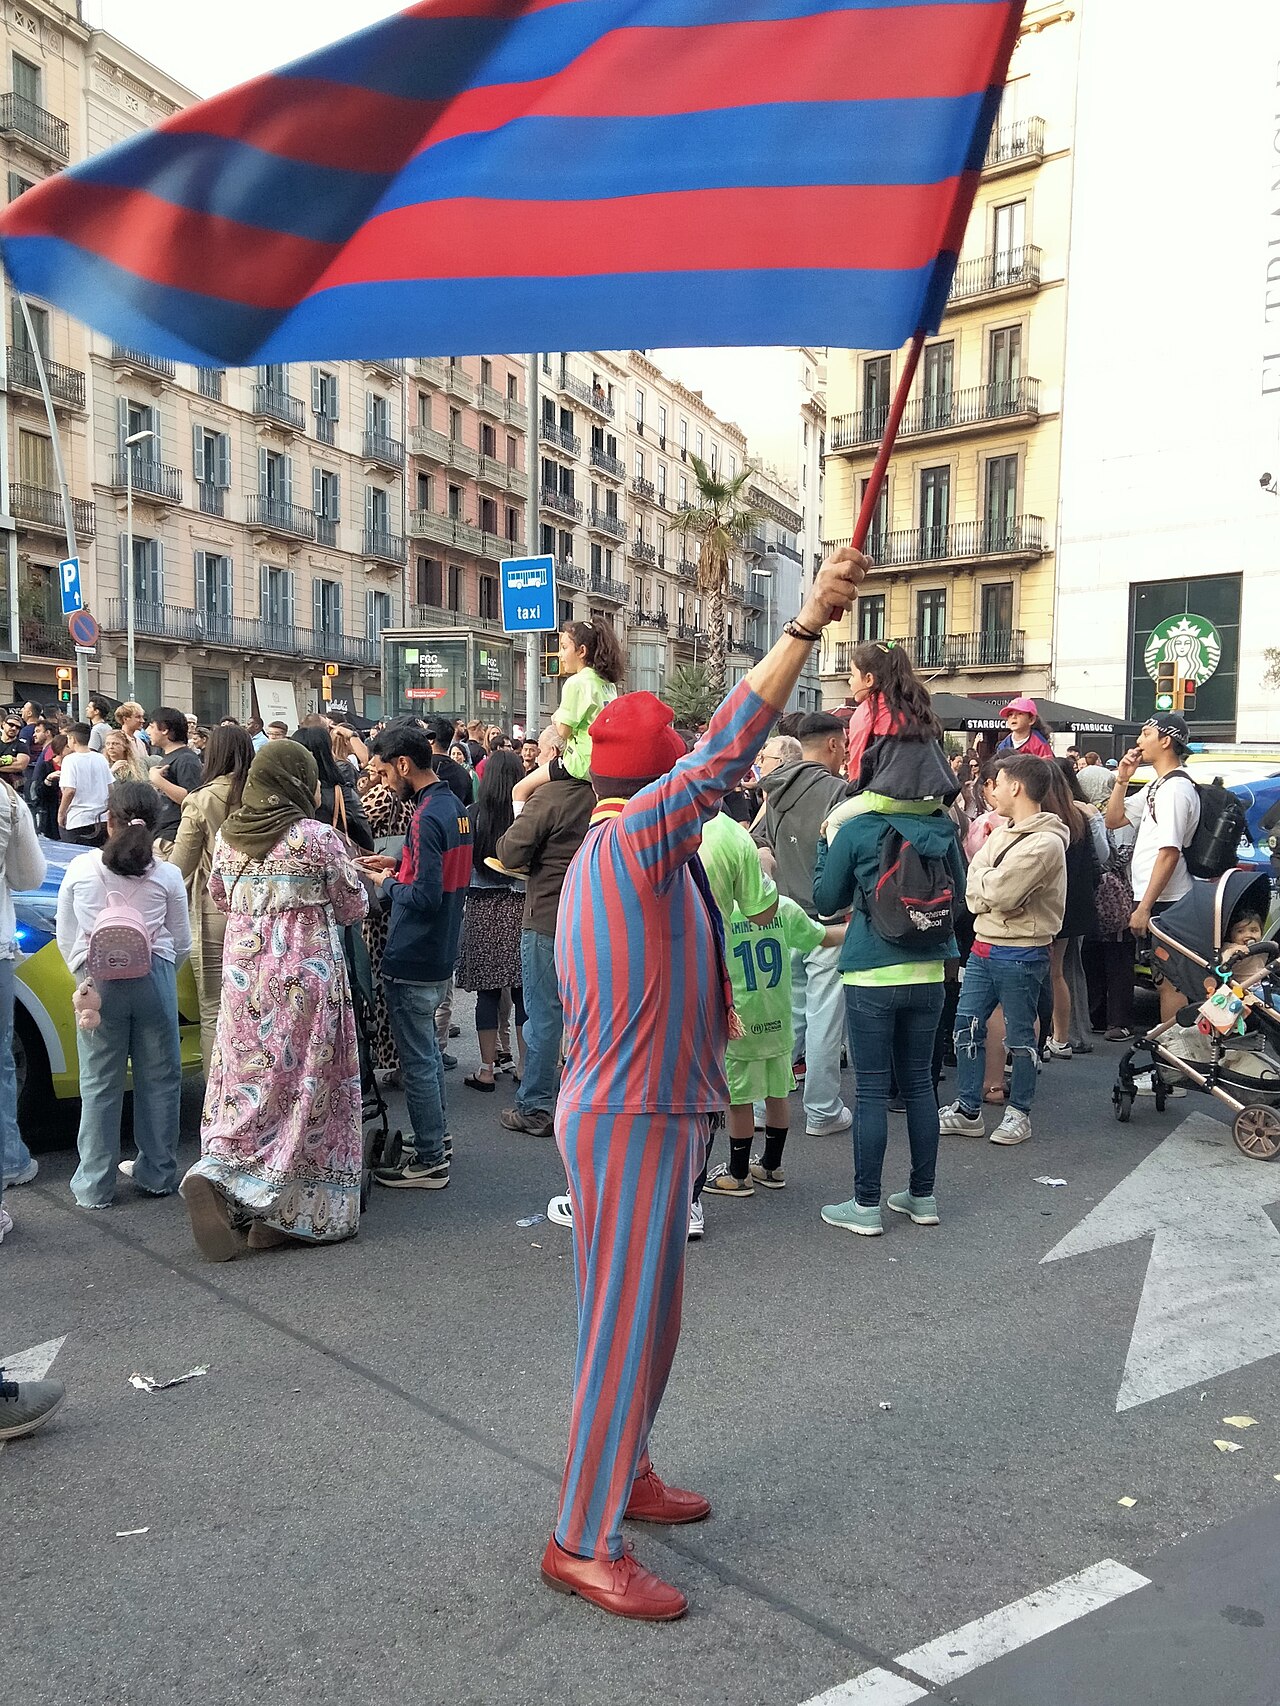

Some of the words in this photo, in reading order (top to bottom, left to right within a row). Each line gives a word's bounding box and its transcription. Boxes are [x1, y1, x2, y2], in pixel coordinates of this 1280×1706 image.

[63, 563, 76, 592] P
[517, 604, 541, 620] taxi
[419, 654, 438, 664] FGC
[487, 657, 497, 668] FGC
[967, 719, 1009, 729] STARBUC
[1070, 722, 1113, 732] STARBUCKS
[733, 937, 783, 992] 19
